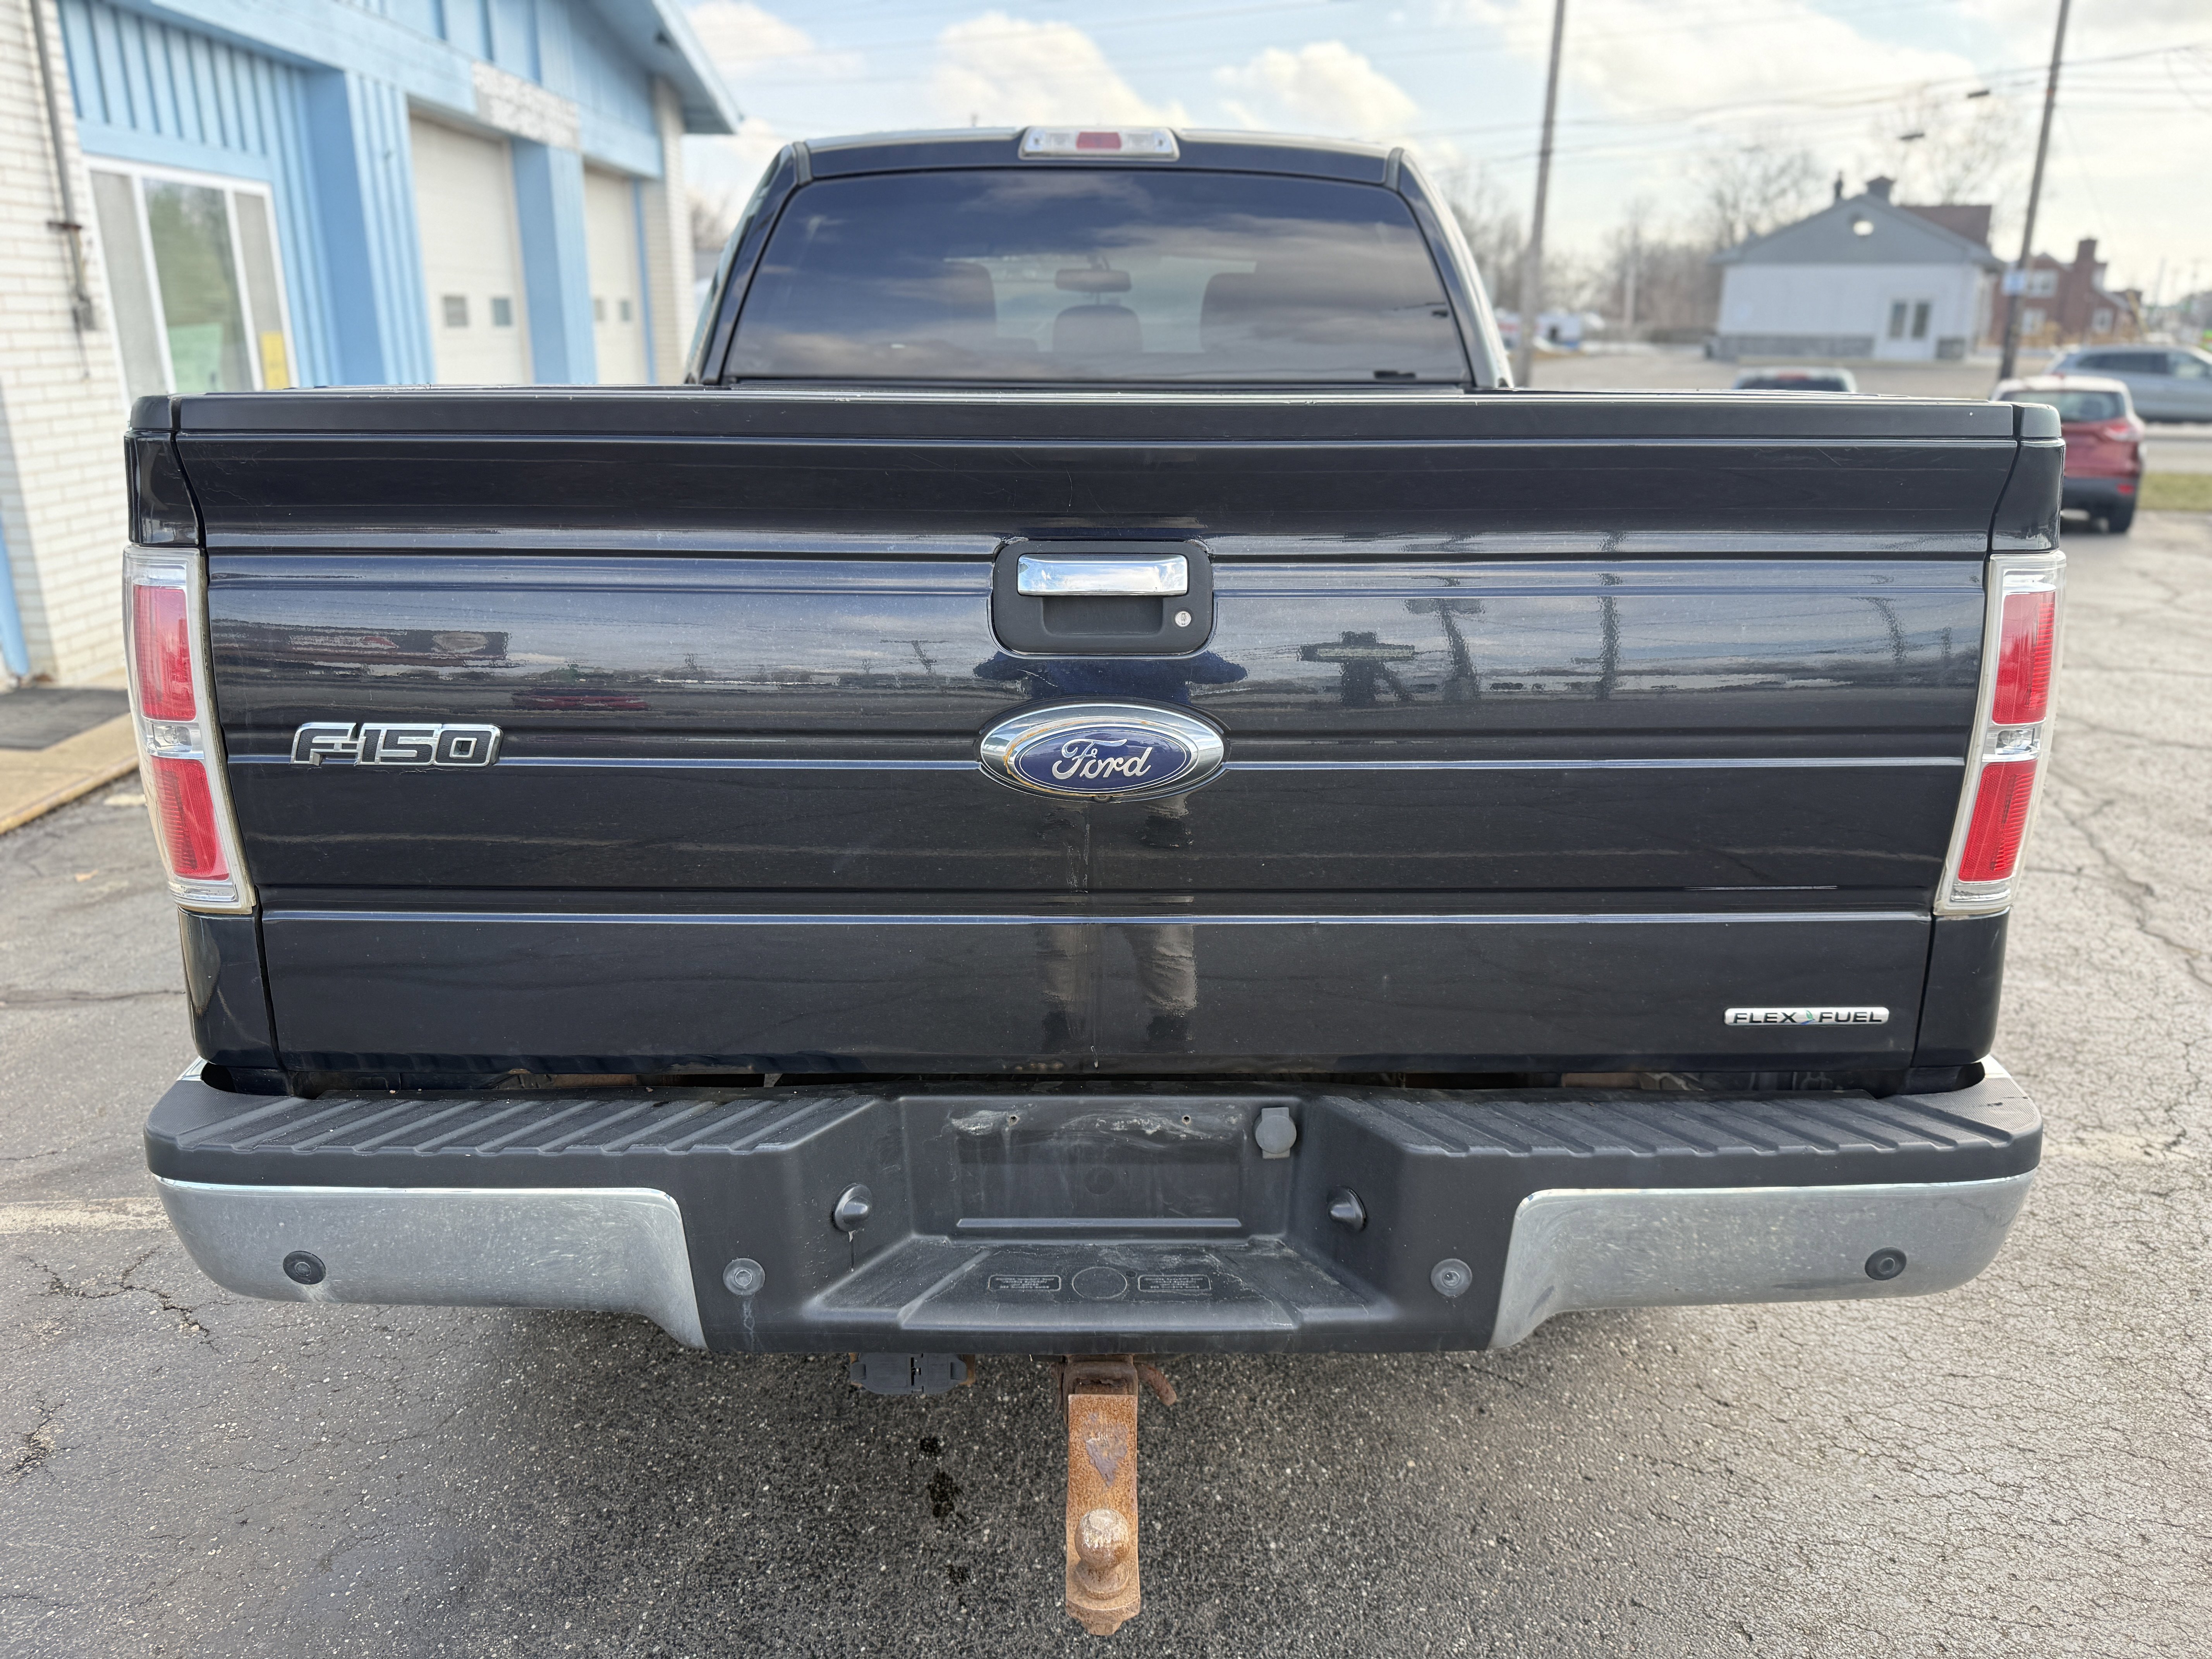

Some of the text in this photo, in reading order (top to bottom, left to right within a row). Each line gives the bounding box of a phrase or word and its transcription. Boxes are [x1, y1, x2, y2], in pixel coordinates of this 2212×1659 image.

[289, 722, 503, 767] F-150
[1052, 738, 1153, 780] Ford
[1733, 1011, 1882, 1024] FLEX FUEL
